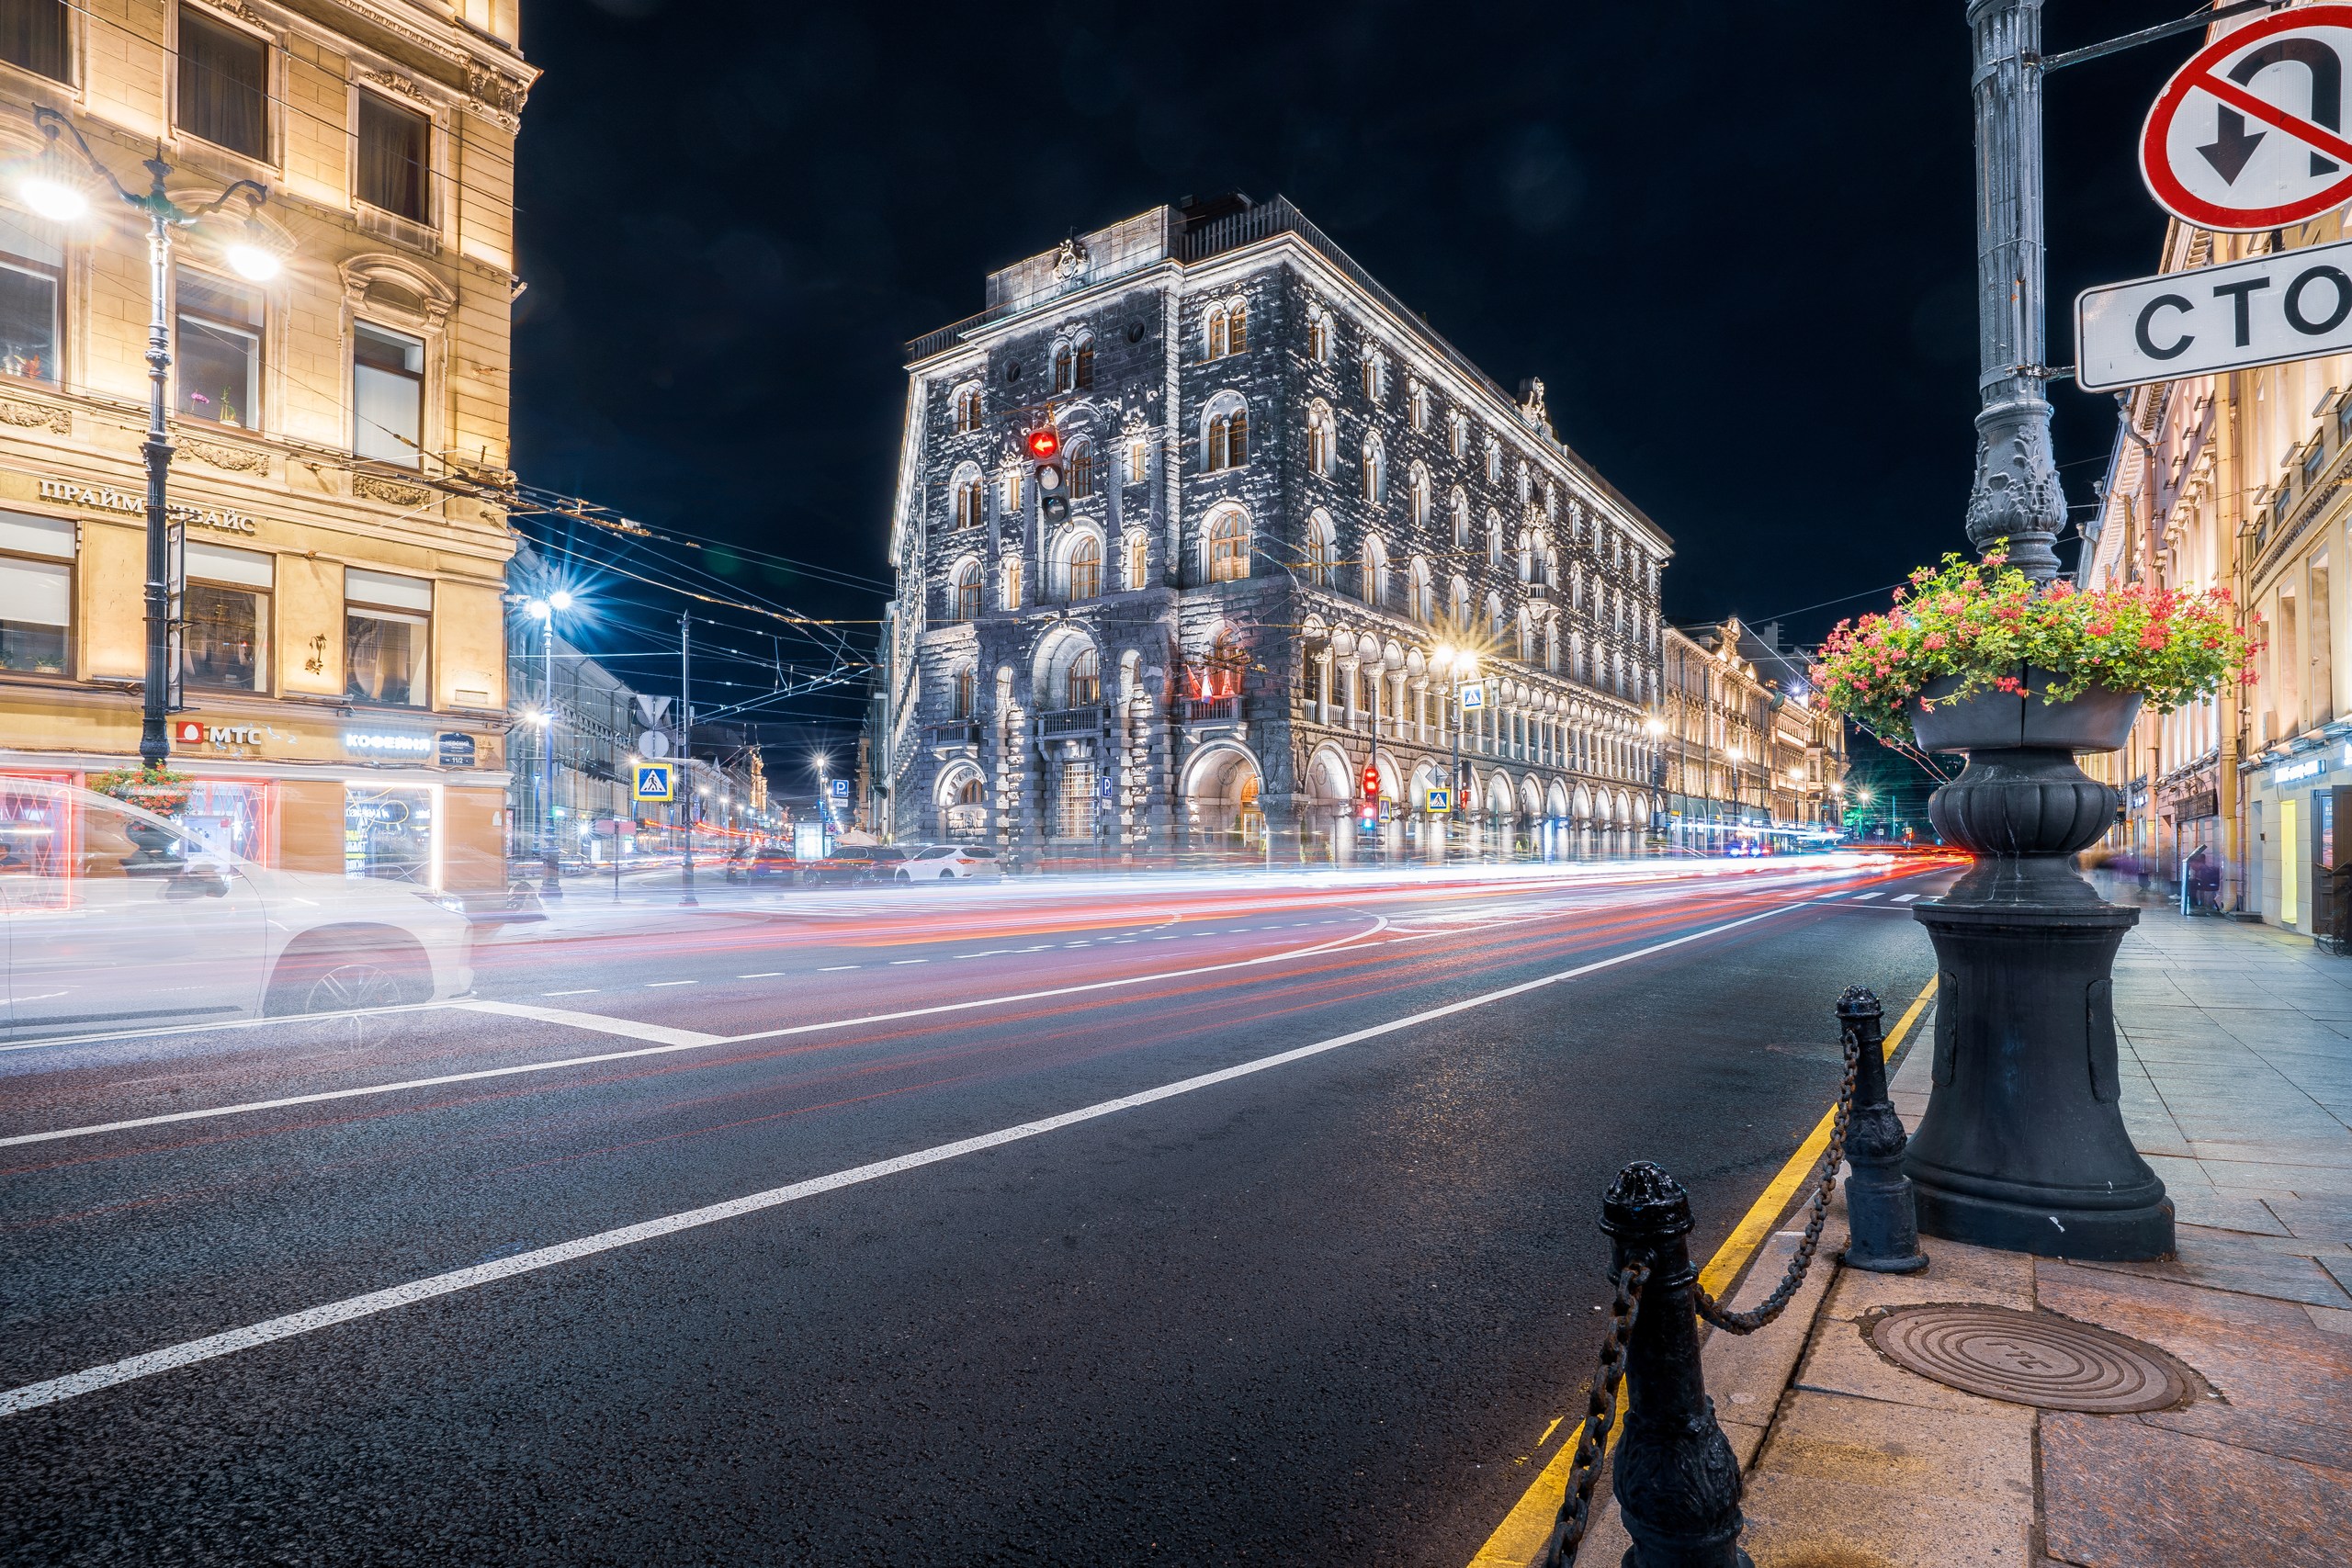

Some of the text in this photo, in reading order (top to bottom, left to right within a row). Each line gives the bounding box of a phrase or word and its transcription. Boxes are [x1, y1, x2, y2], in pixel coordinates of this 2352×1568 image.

[2135, 265, 2352, 361] СТО
[39, 479, 255, 533] ПРАЙМ ДВАЙС
[209, 726, 262, 745] МТС
[836, 782, 845, 795] P
